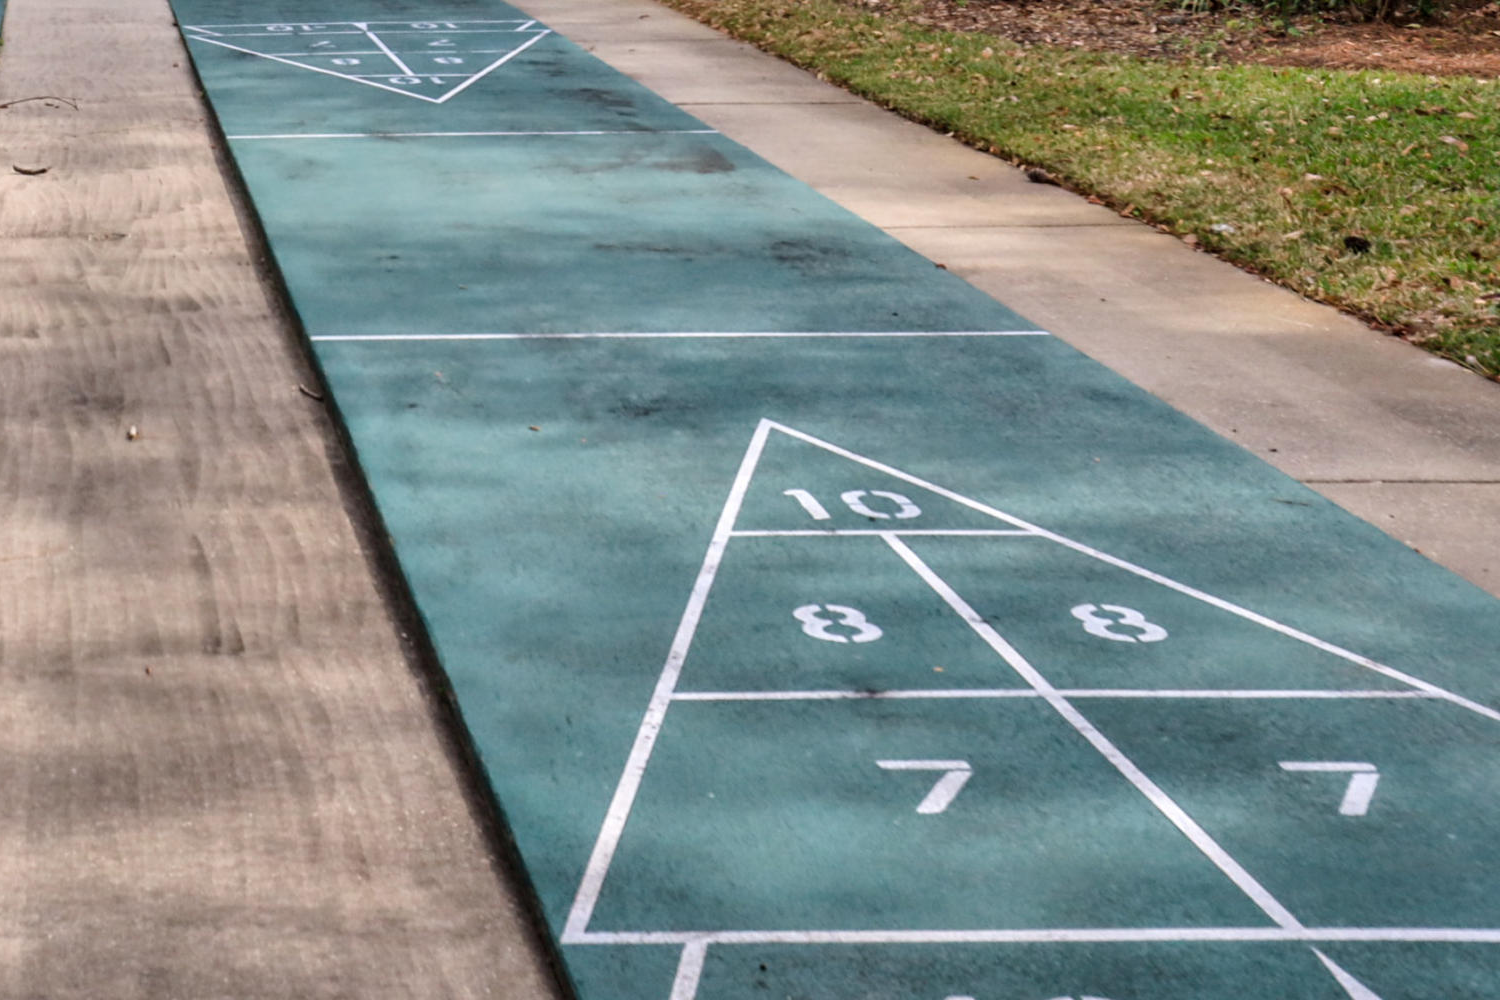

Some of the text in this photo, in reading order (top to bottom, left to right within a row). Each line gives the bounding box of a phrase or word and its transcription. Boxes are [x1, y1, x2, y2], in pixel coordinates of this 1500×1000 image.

[388, 76, 446, 85] 10
[782, 488, 923, 521] 10
[792, 604, 883, 643] 8
[1070, 603, 1169, 643] 8
[875, 760, 974, 815] 7
[1278, 761, 1380, 816] 7
